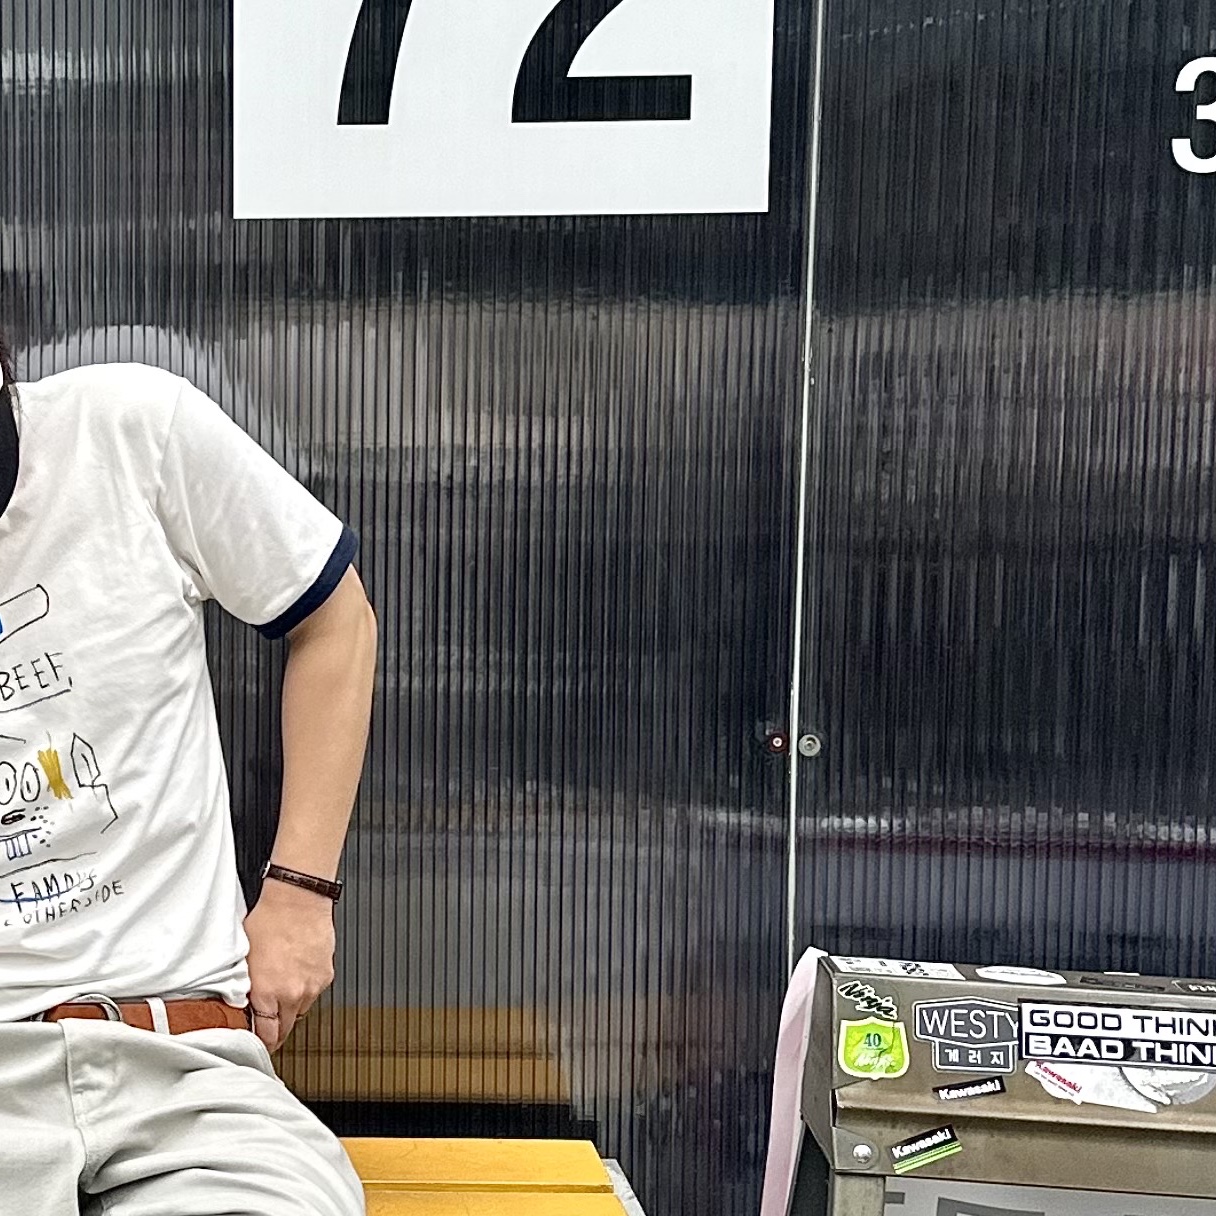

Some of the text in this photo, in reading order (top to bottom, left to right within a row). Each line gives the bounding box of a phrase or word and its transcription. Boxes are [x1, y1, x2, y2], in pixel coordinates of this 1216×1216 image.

[922, 1008, 1019, 1039] WESTY
[1029, 1009, 1216, 1037] GOOD THIN
[863, 1032, 882, 1048] 40
[1028, 1035, 1216, 1066] BAAD THIN
[938, 1079, 1001, 1100] Kawasaki
[891, 1128, 952, 1159] Kawasaki
